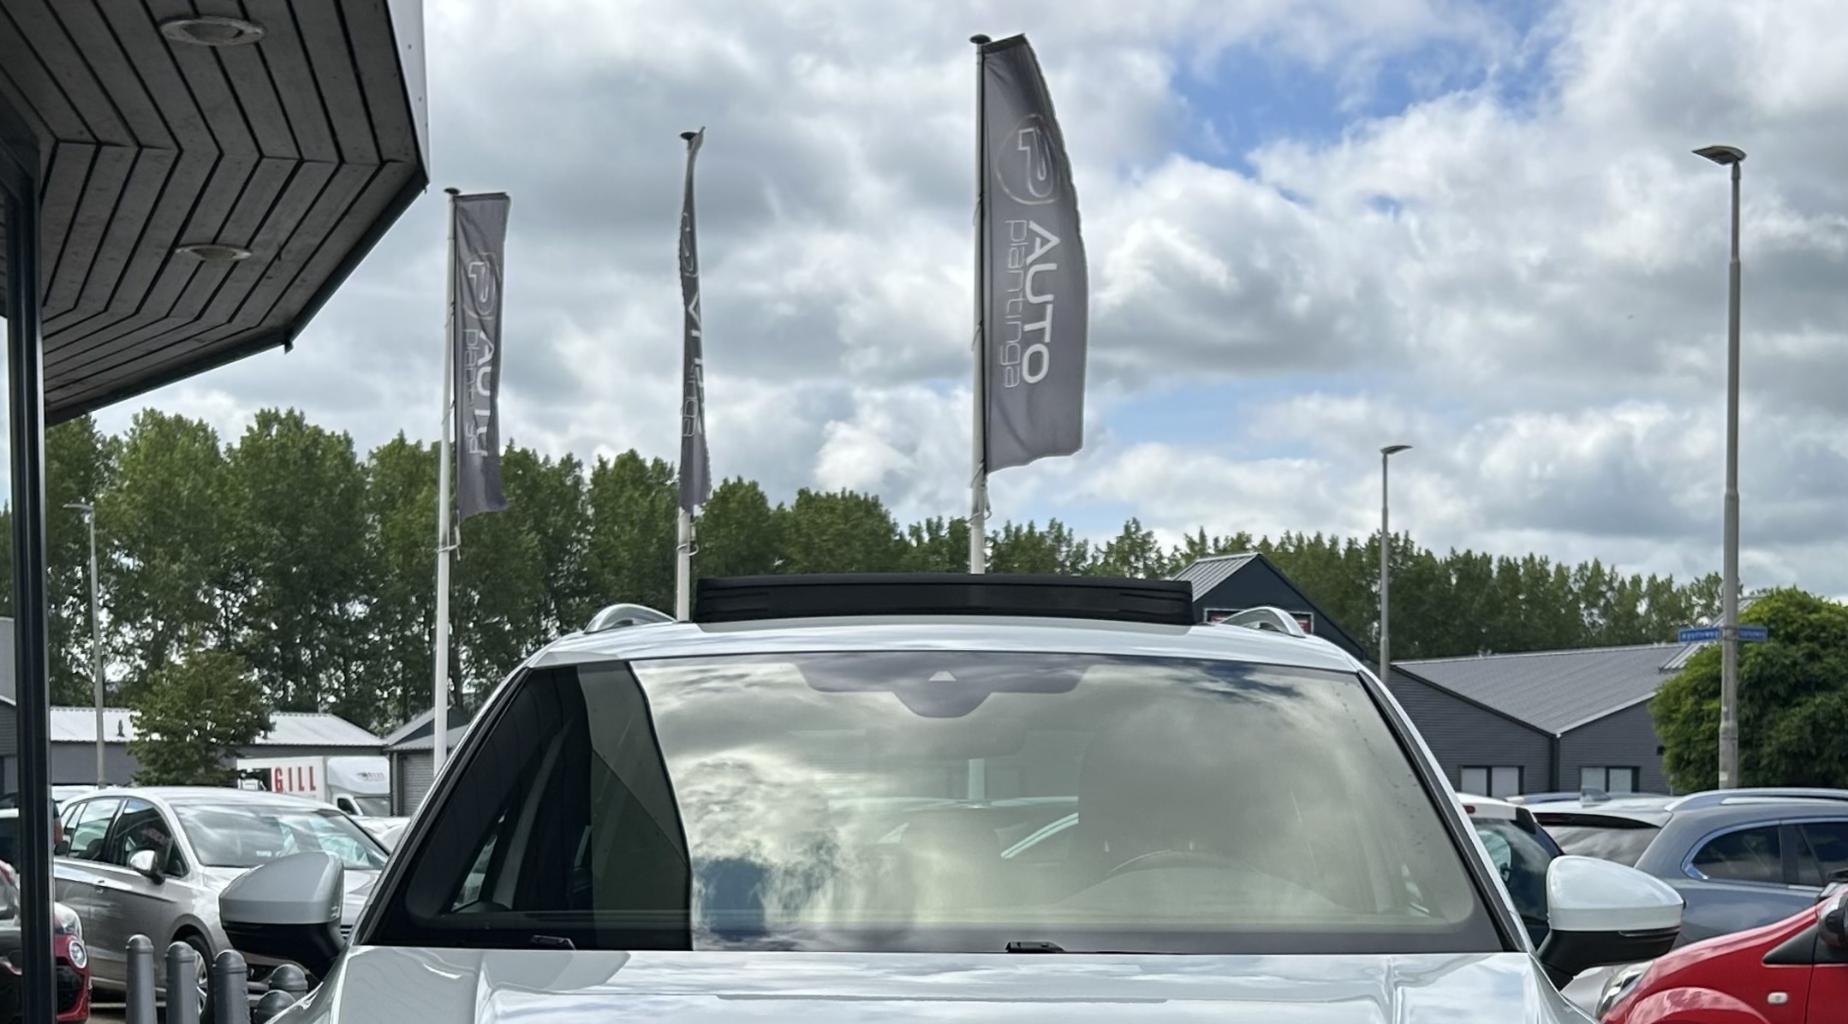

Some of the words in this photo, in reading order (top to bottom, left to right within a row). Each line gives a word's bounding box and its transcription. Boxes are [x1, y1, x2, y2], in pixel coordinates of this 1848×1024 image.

[1000, 219, 1029, 389] plantinga
[1022, 219, 1062, 385] AUTO
[274, 766, 317, 793] GILL
